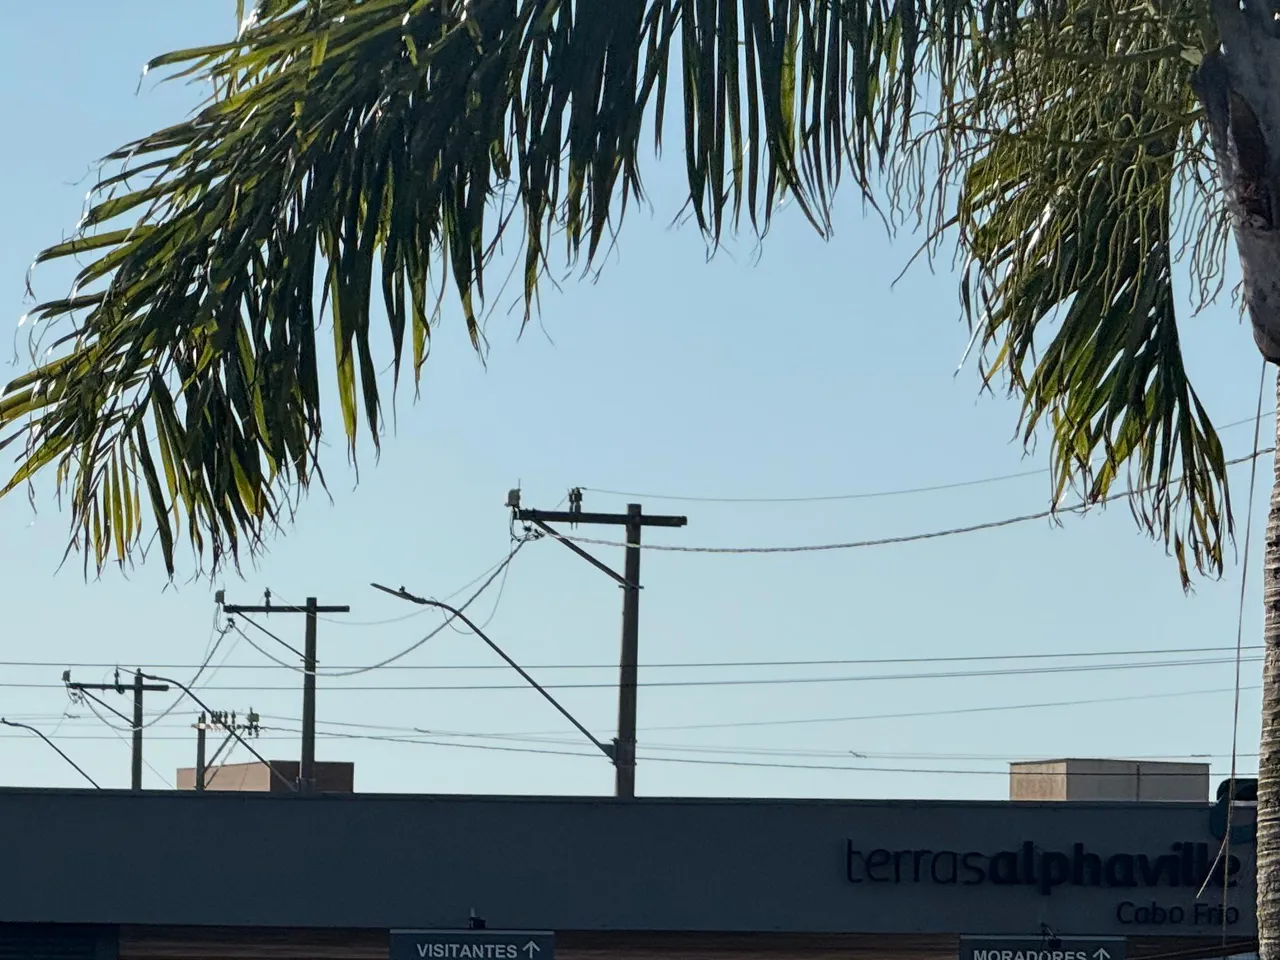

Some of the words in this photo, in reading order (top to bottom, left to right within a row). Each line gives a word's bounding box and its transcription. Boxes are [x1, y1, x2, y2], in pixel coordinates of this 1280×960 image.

[1117, 901, 1184, 925] Cabo
[1194, 903, 1240, 925] Frio
[416, 943, 518, 959] VISITANTES
